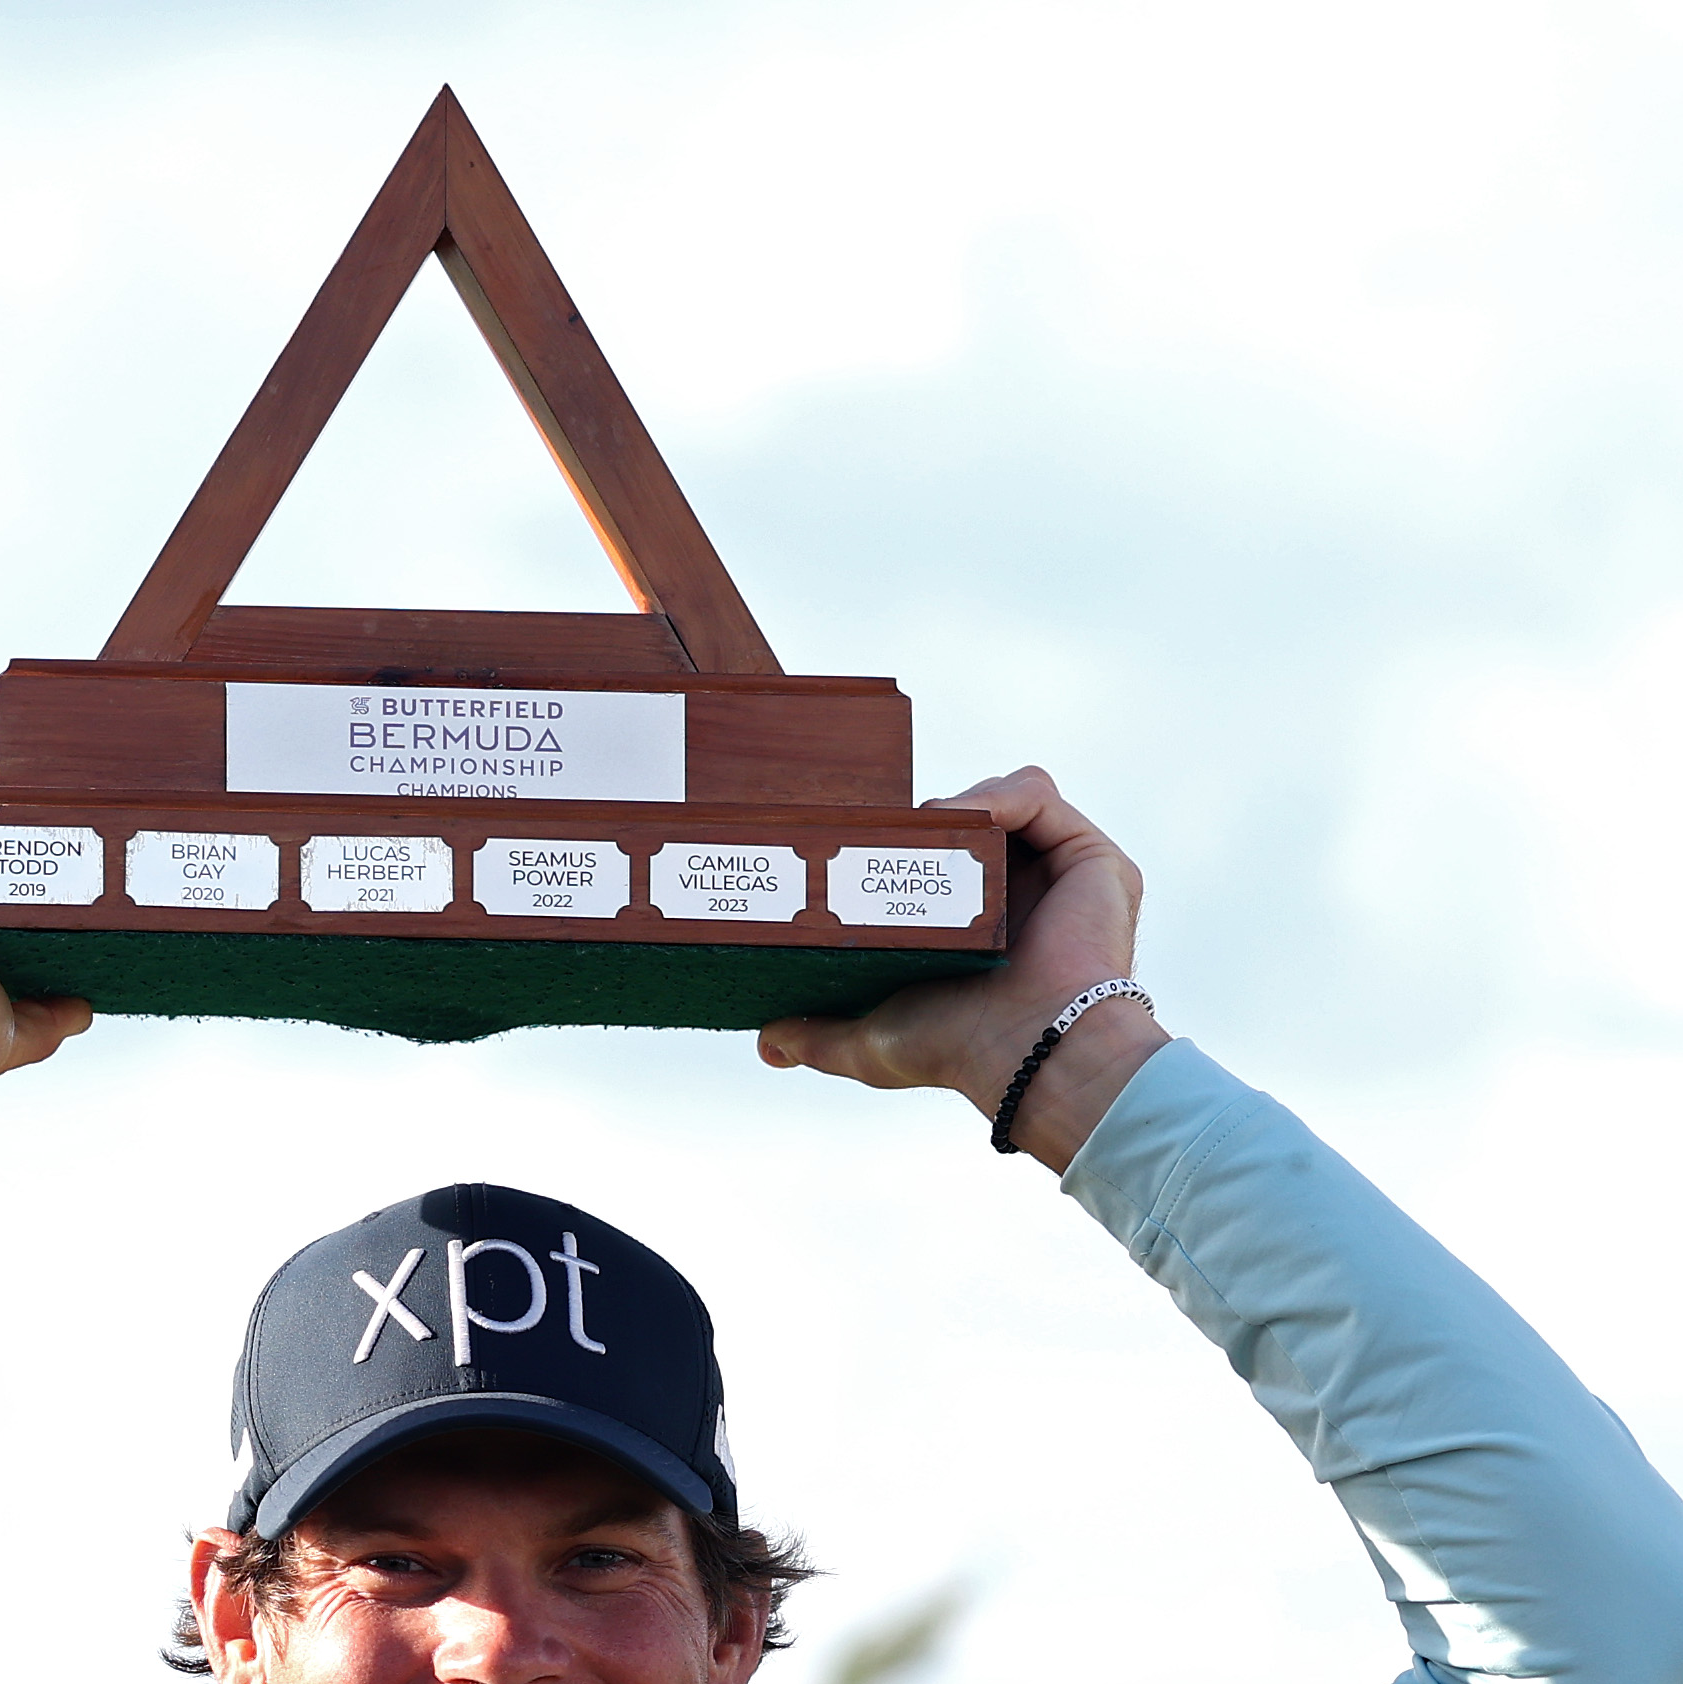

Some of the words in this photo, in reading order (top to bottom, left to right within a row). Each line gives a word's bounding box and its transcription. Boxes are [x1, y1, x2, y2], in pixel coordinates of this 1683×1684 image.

[382, 698, 564, 720] BUTTERFIELD
[349, 722, 564, 753] BERMUDA
[349, 755, 564, 777] CHAMPIONSHIP
[397, 782, 518, 799] CHAMPIONS
[171, 843, 237, 862] BRIAN
[342, 845, 411, 862] LUCAS
[508, 850, 597, 869] SEAMUS
[182, 863, 226, 880] GAY
[326, 863, 427, 882] HERBERT
[687, 854, 770, 873] CAMILO
[867, 858, 948, 877] RAFAEL
[512, 869, 593, 888] POWER
[679, 873, 779, 892] VILLEGAS
[860, 877, 953, 896] CAMPOS
[8, 883, 46, 897] 2019
[182, 886, 225, 901] 2020
[357, 888, 395, 902] 2021
[532, 894, 574, 909] 2022
[707, 898, 749, 913] 2023
[885, 901, 928, 916] 2024
[352, 1231, 606, 1367] xpt
